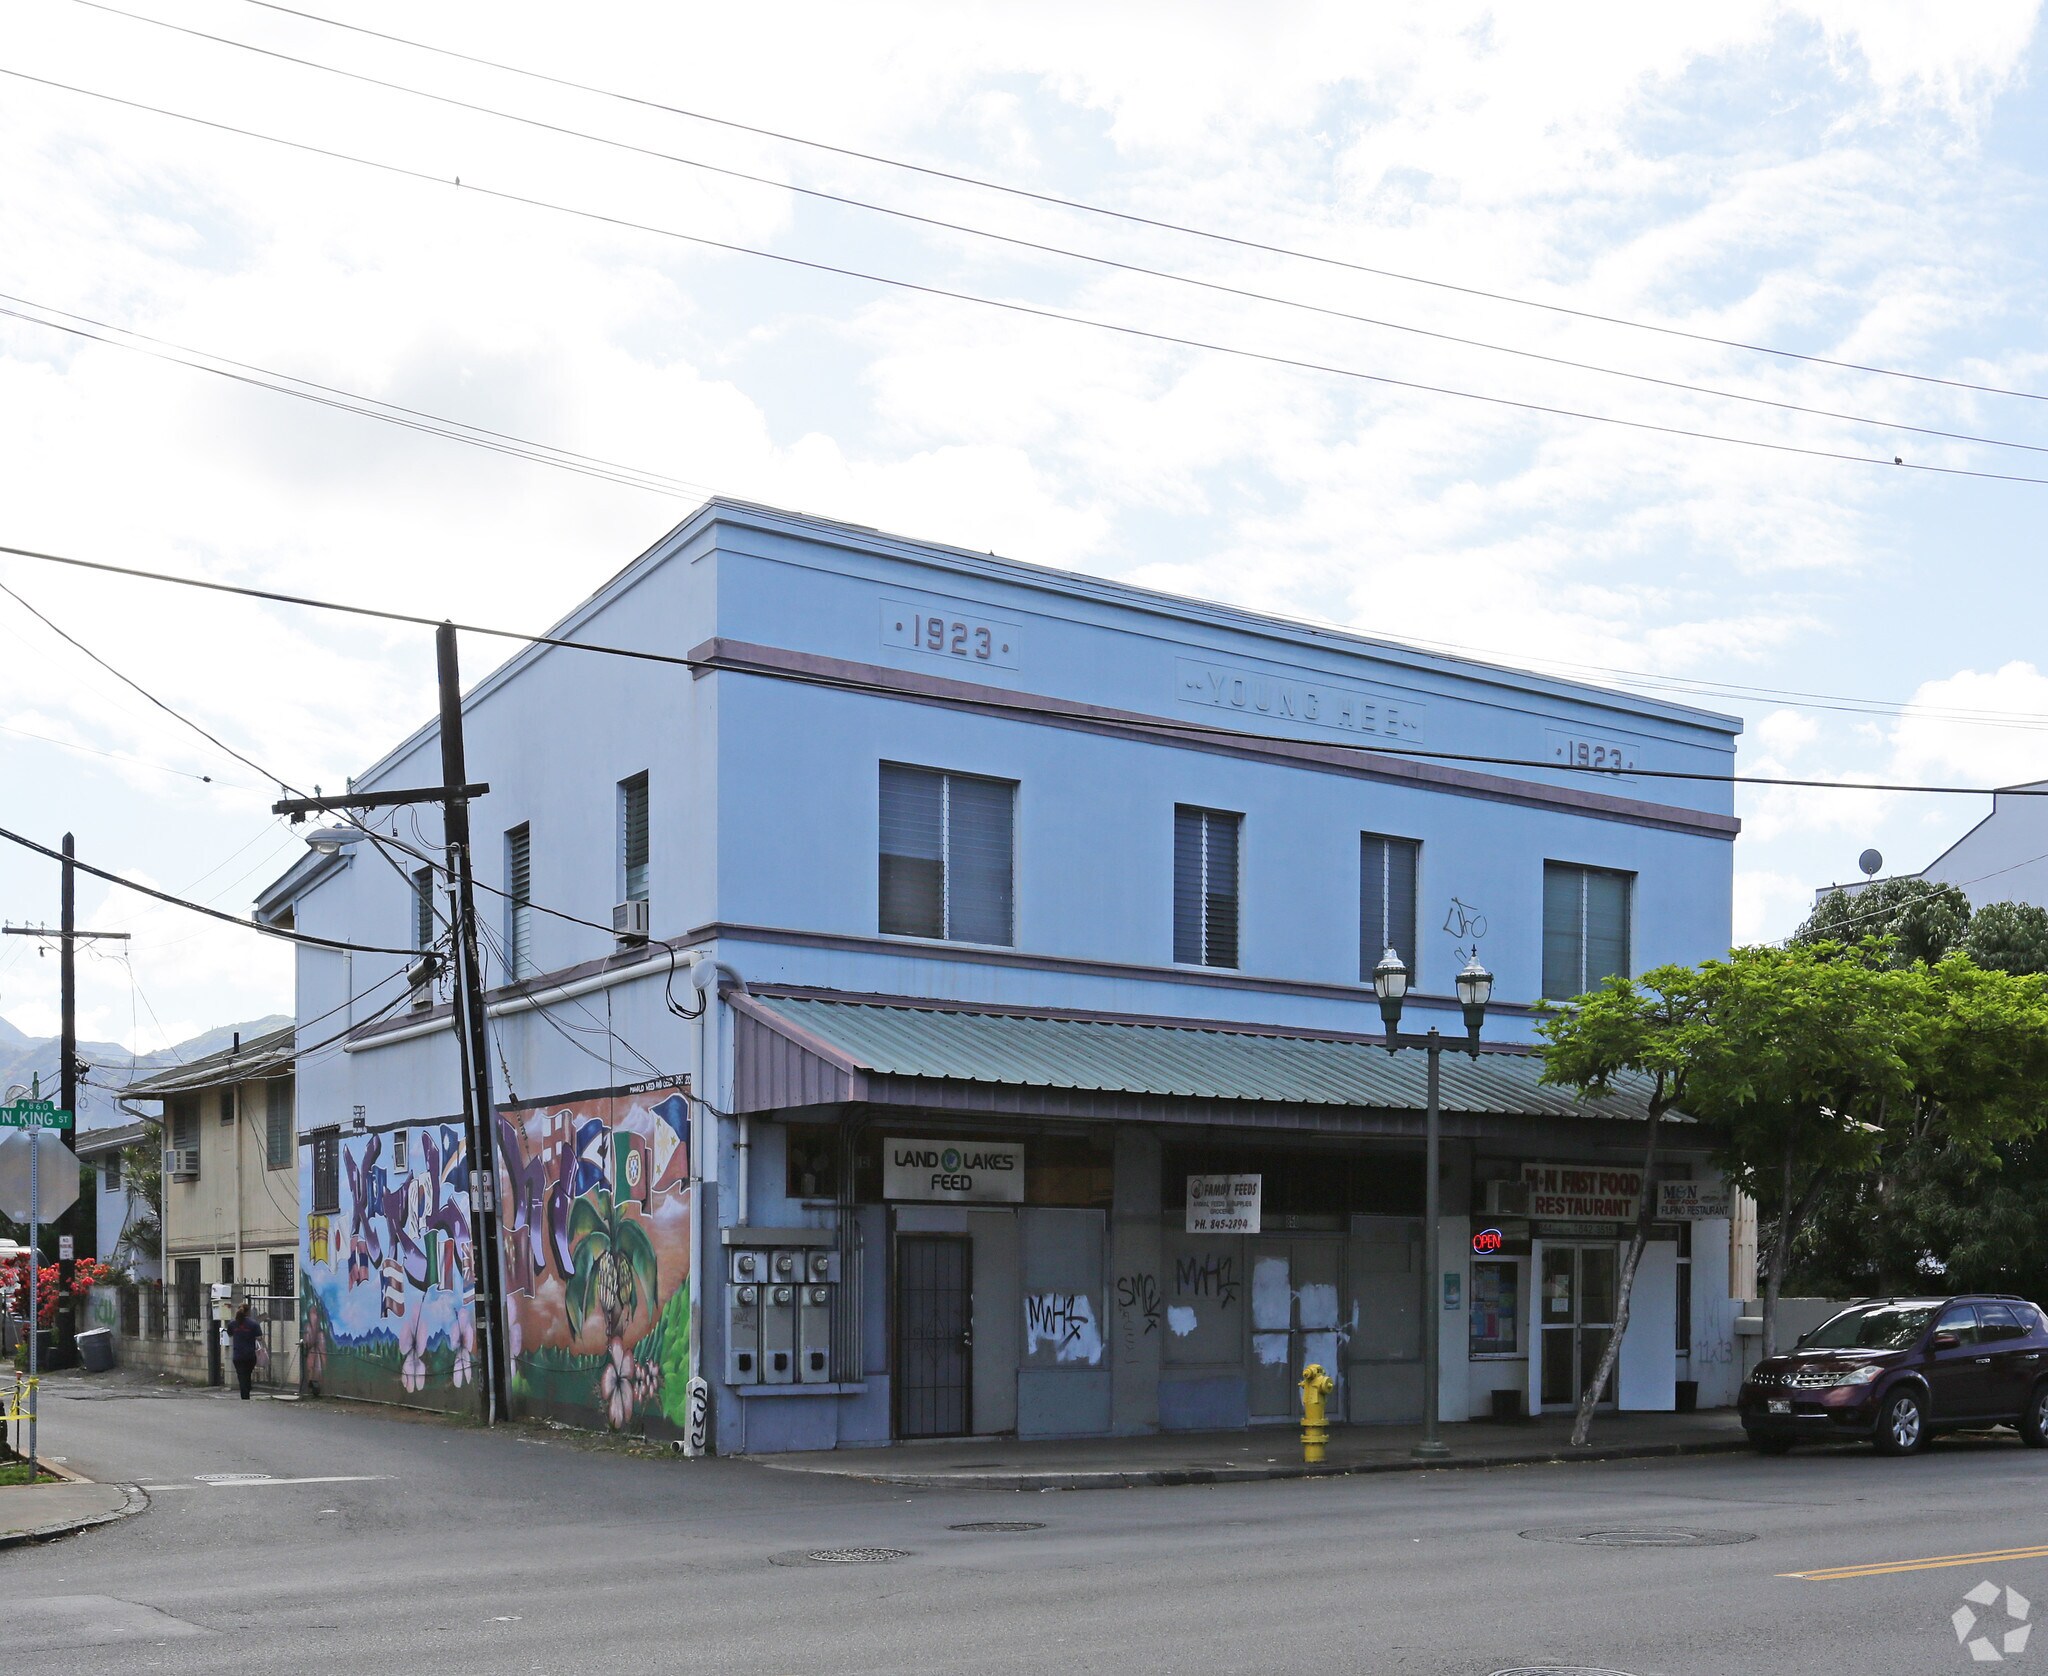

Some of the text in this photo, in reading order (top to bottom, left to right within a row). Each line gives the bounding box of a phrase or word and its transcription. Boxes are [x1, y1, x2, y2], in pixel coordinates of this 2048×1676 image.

[913, 614, 991, 660] 1923
[1207, 671, 1320, 720] YOUNG
[1568, 740, 1622, 776] 1923
[2, 1110, 69, 1128] N. KING ST
[894, 1150, 939, 1168] LAND
[963, 1153, 1014, 1171] LAKES
[931, 1174, 972, 1191] FEED
[1204, 1183, 1257, 1196] FAMILY FEEDS
[1561, 1170, 1598, 1195] FAST
[1599, 1172, 1640, 1197] FOOD
[1535, 1196, 1632, 1217] RESTAURANT
[1687, 1205, 1729, 1215] RESTAURANT
[1473, 1234, 1501, 1249] OPEN
